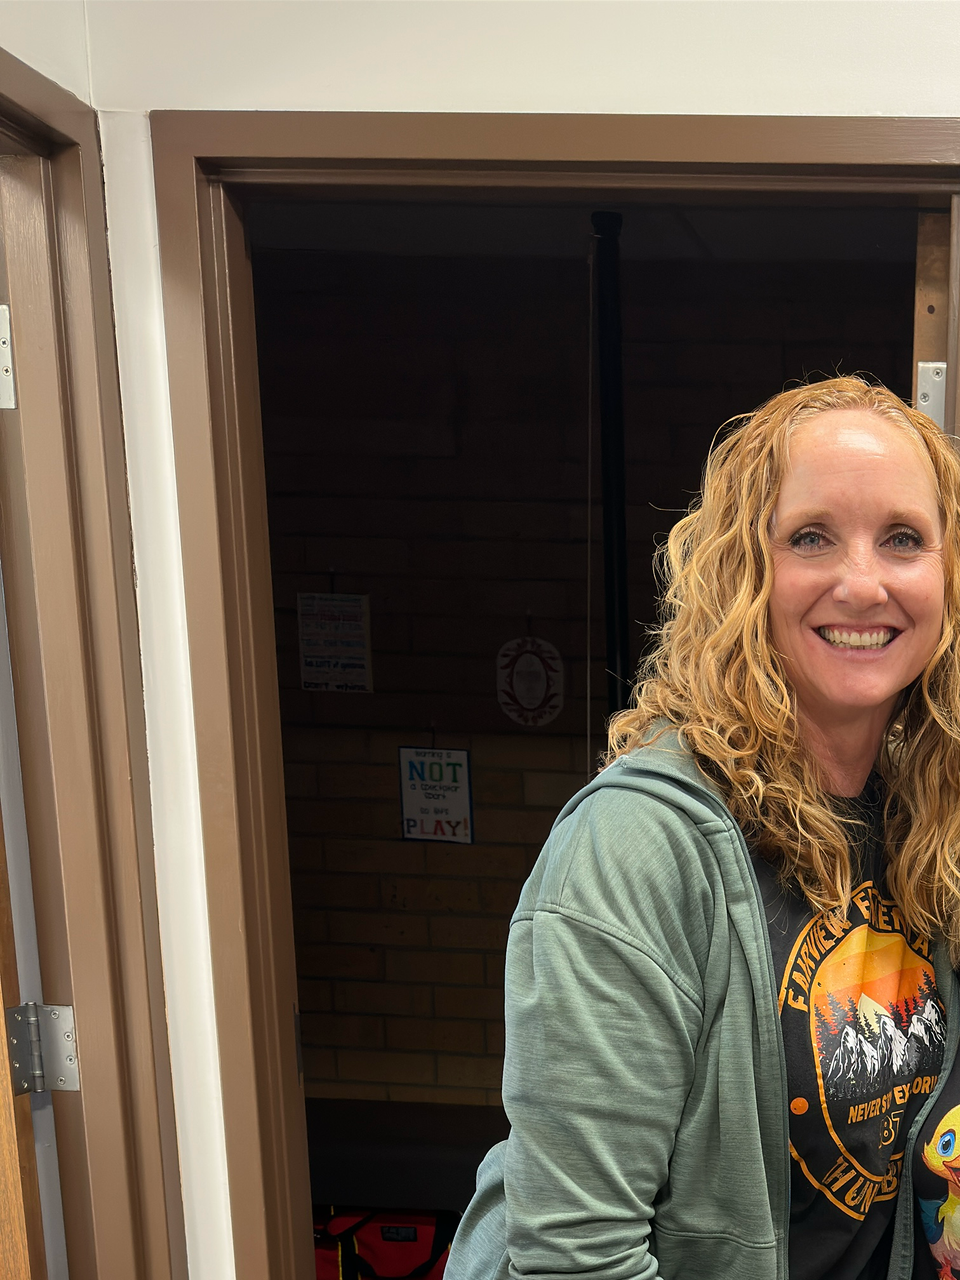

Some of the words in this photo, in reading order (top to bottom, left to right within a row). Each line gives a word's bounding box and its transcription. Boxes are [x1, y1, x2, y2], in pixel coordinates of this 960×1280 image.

[408, 760, 462, 783] NOT
[406, 818, 469, 836] PLAY!
[848, 1098, 881, 1124] NEVER
